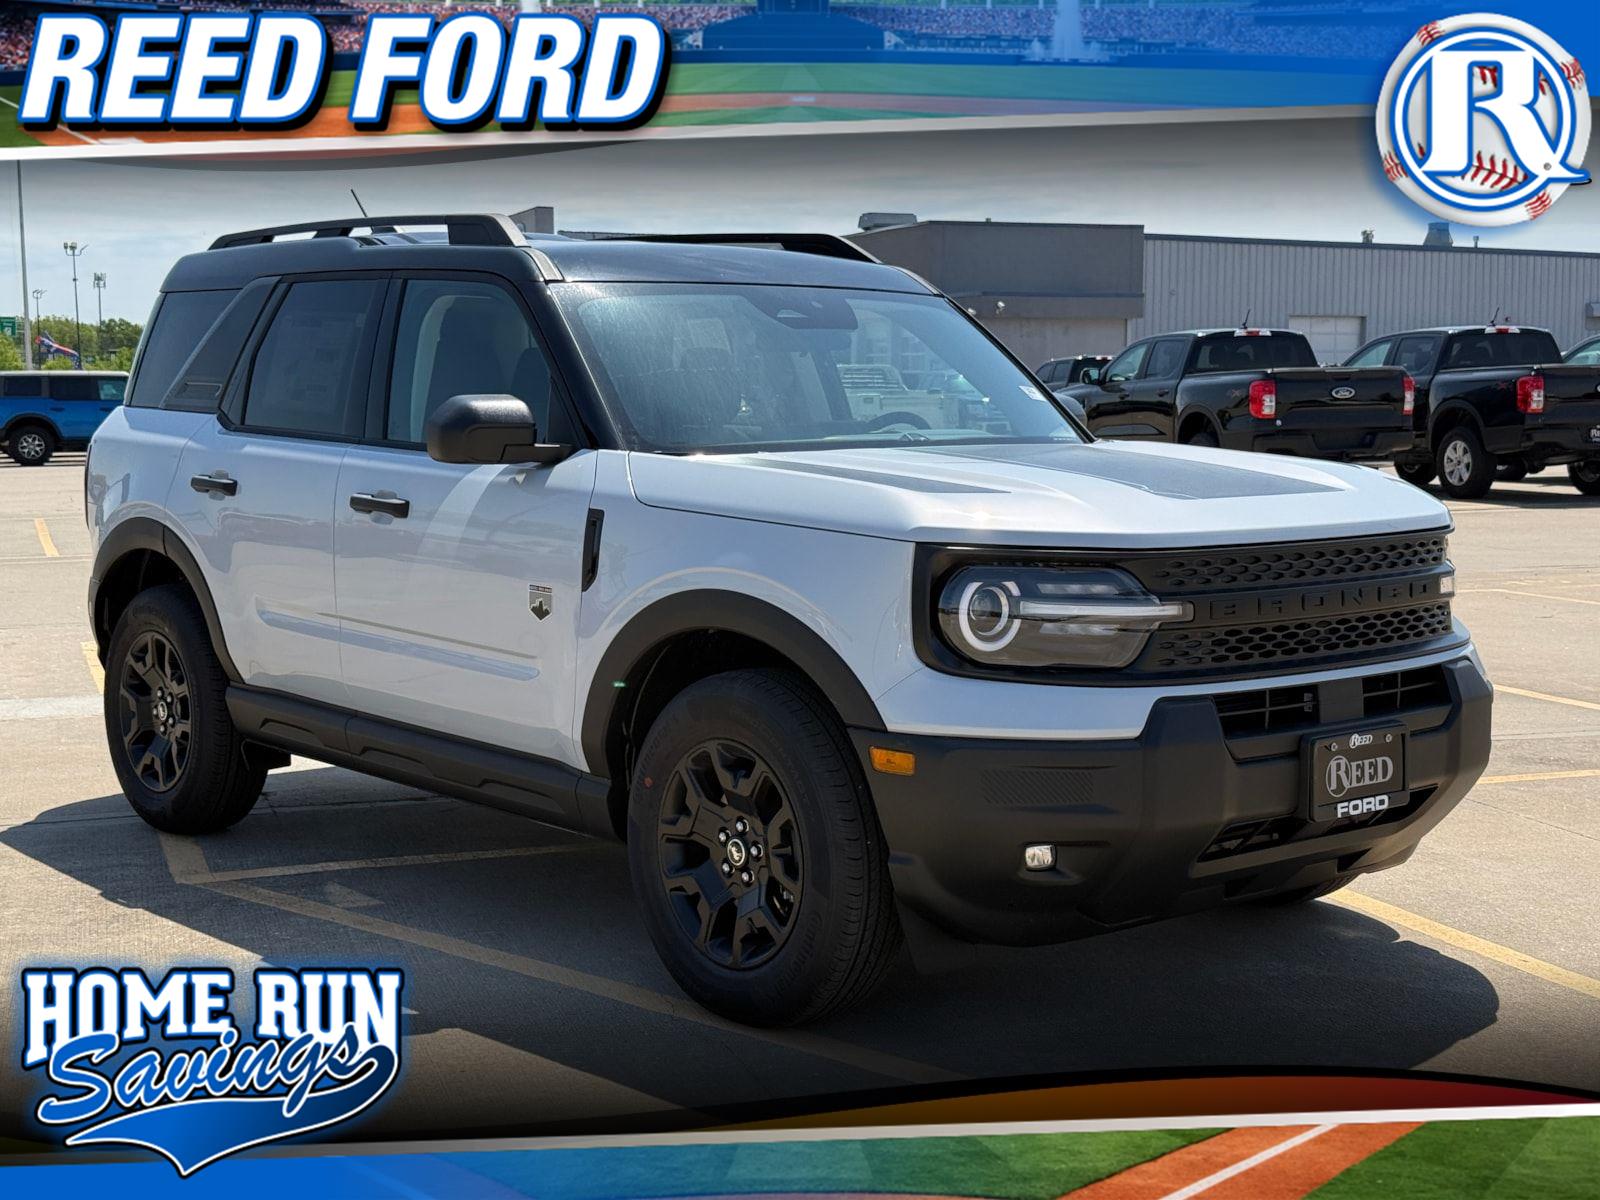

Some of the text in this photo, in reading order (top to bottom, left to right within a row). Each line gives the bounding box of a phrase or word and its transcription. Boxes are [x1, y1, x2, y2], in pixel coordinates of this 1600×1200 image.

[1349, 734, 1373, 748] REED
[1326, 756, 1394, 797] REED
[1337, 795, 1389, 818] FORD
